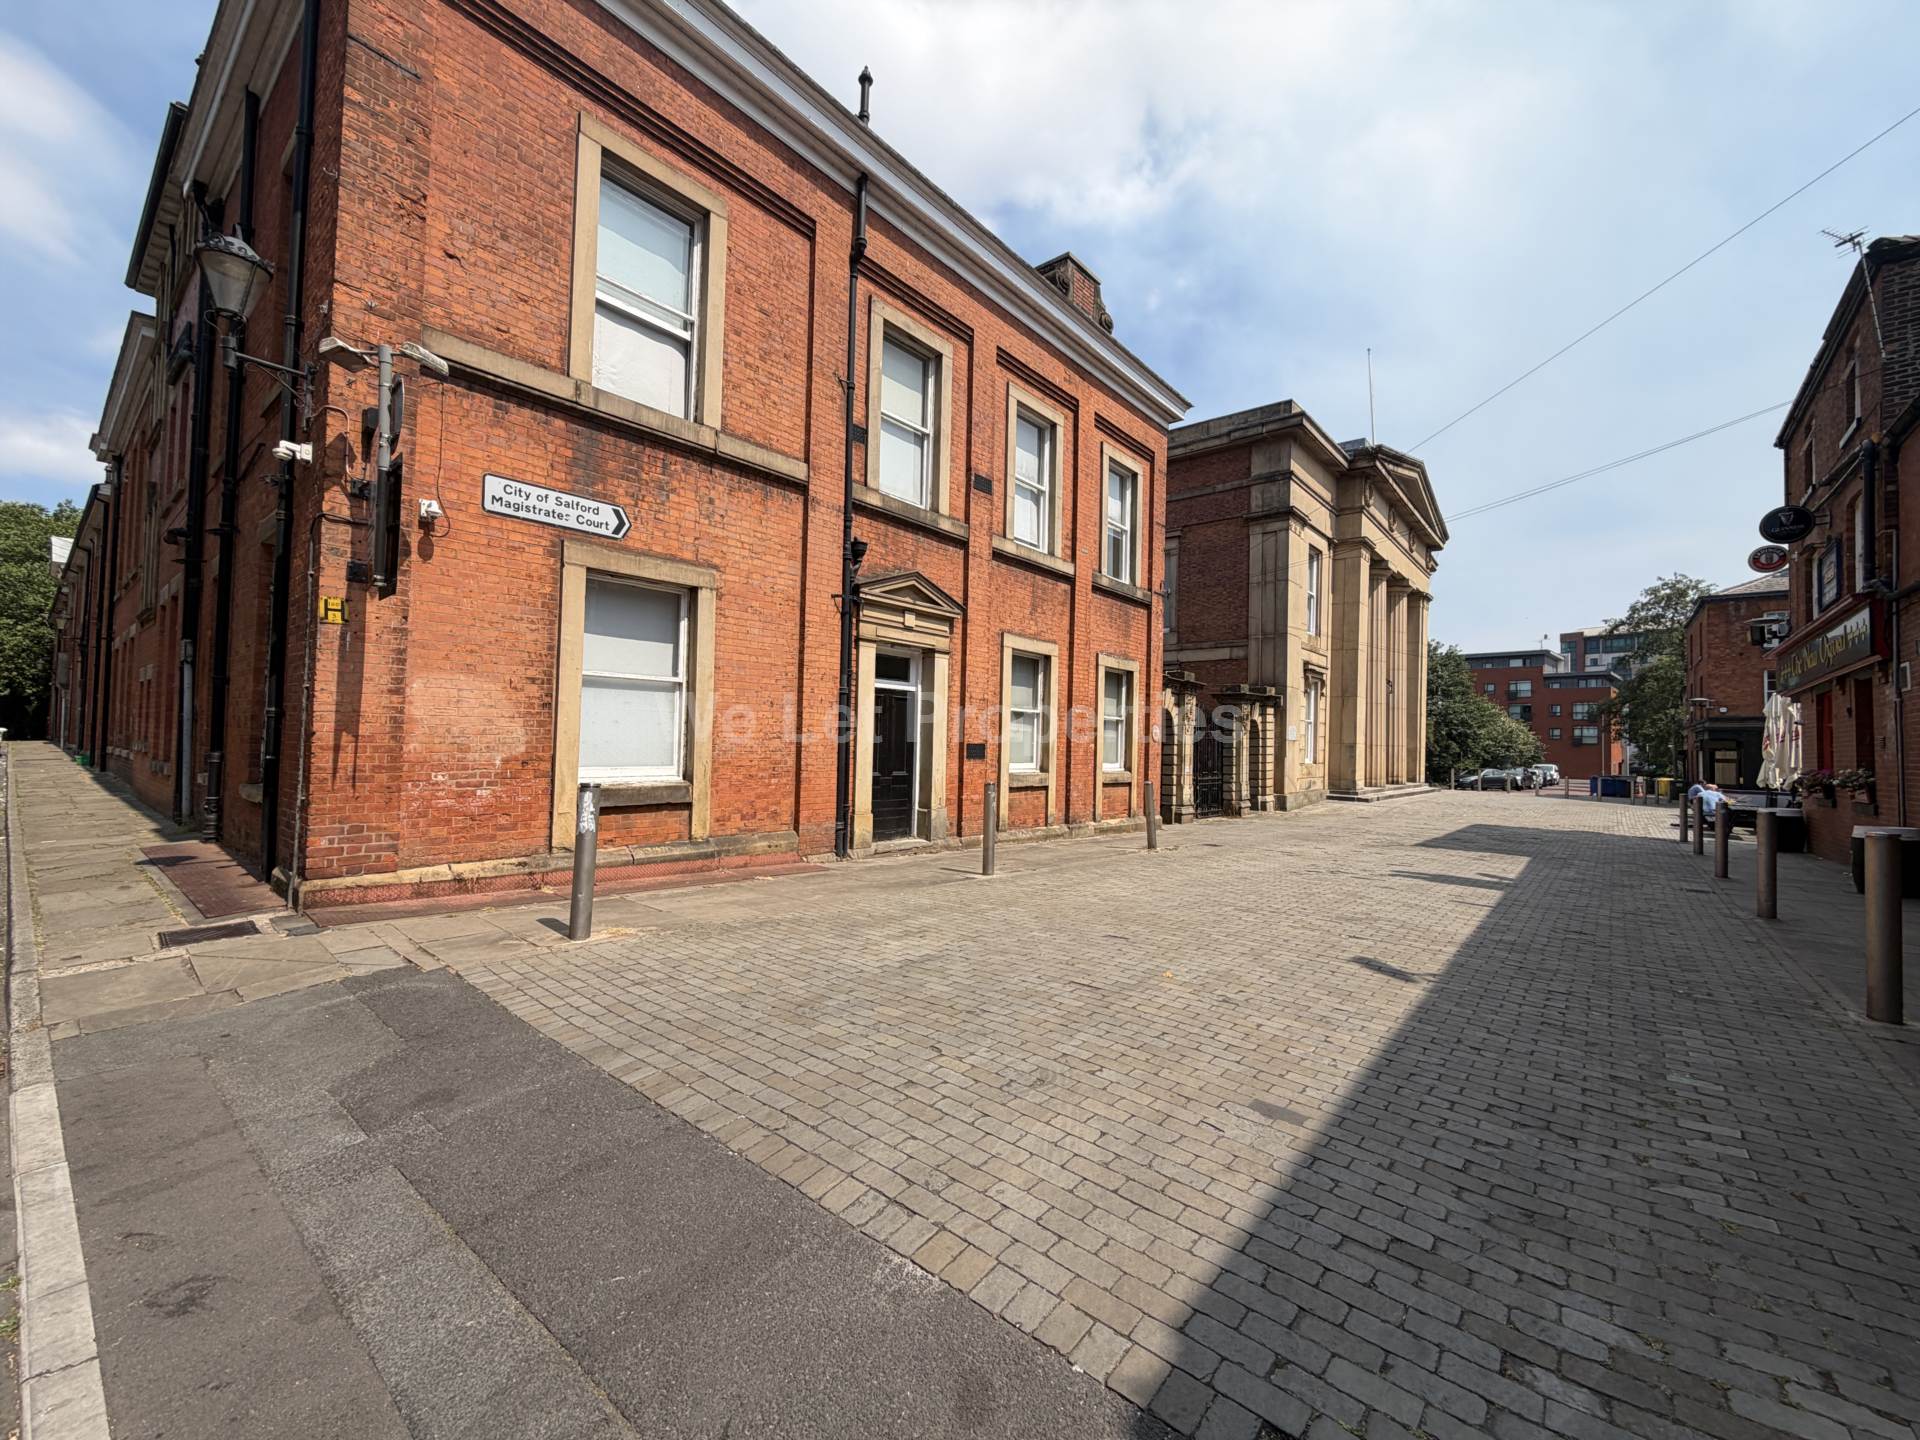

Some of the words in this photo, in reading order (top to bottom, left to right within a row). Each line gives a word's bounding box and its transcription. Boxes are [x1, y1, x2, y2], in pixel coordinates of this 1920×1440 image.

[491, 495, 571, 521] Magistrates
[576, 515, 610, 531] Court
[503, 484, 531, 501] City
[536, 493, 550, 504] of
[555, 497, 600, 516] Salford
